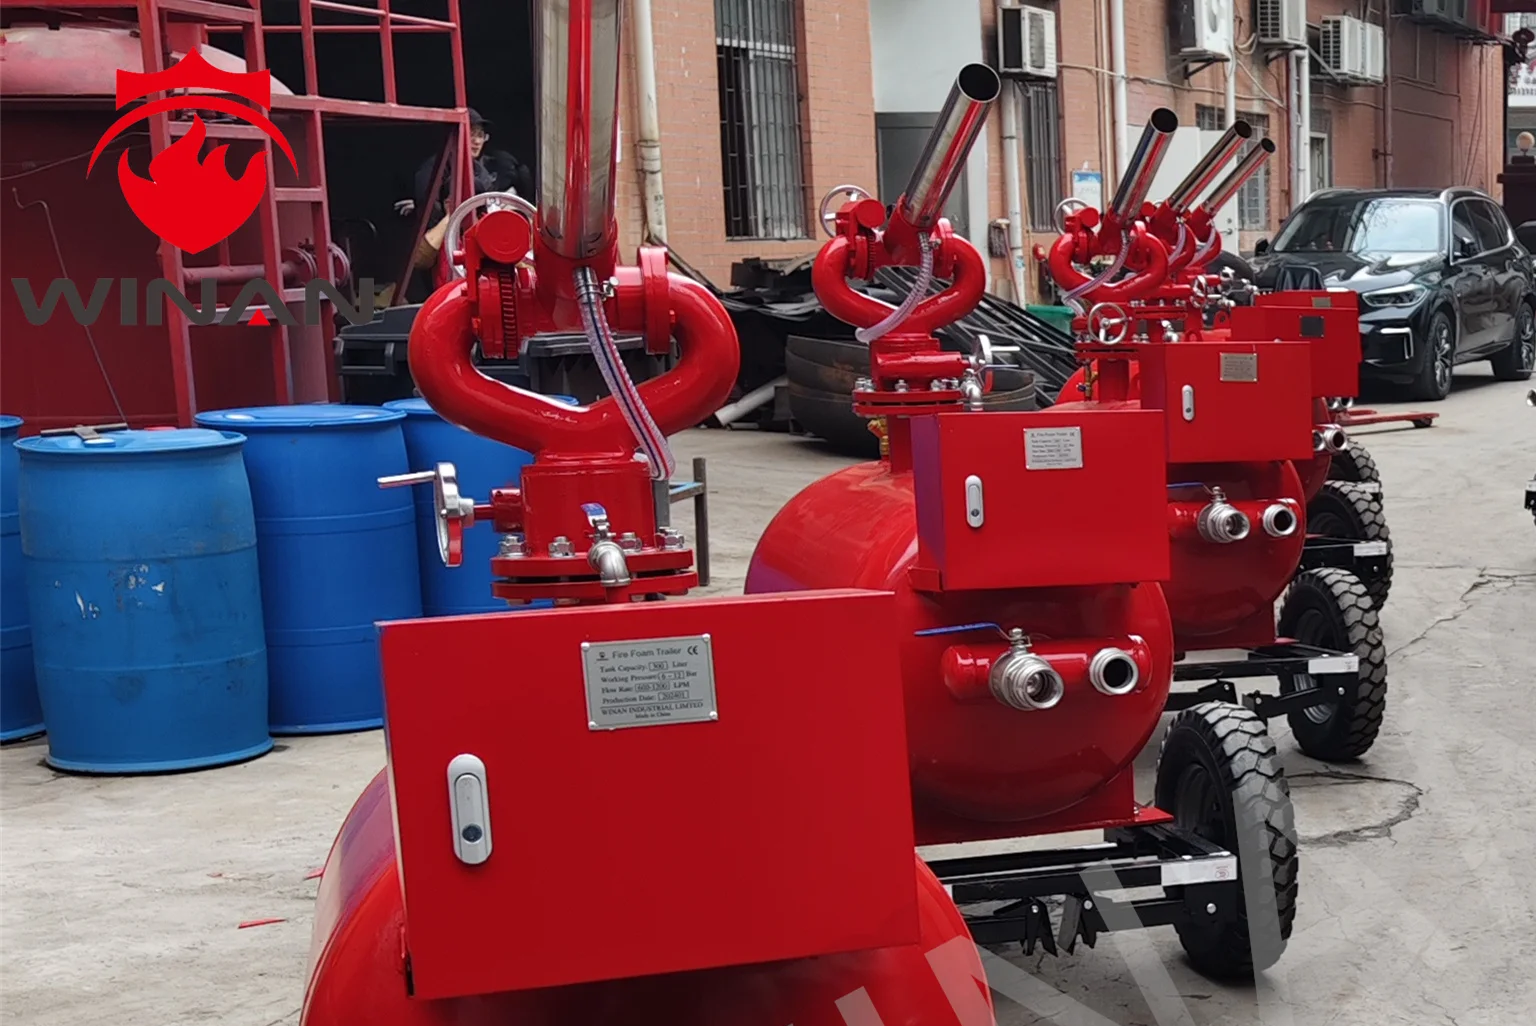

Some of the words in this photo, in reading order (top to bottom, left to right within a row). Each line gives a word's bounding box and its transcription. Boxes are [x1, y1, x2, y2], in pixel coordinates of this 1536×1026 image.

[612, 649, 629, 659] Fire
[630, 648, 655, 658] Foam
[656, 647, 682, 656] Trailer
[600, 665, 616, 673] Tank
[601, 675, 630, 683] Working
[673, 681, 690, 689] LPM
[601, 707, 628, 715] WINAN
[628, 704, 674, 714] INDUSTRIAL
